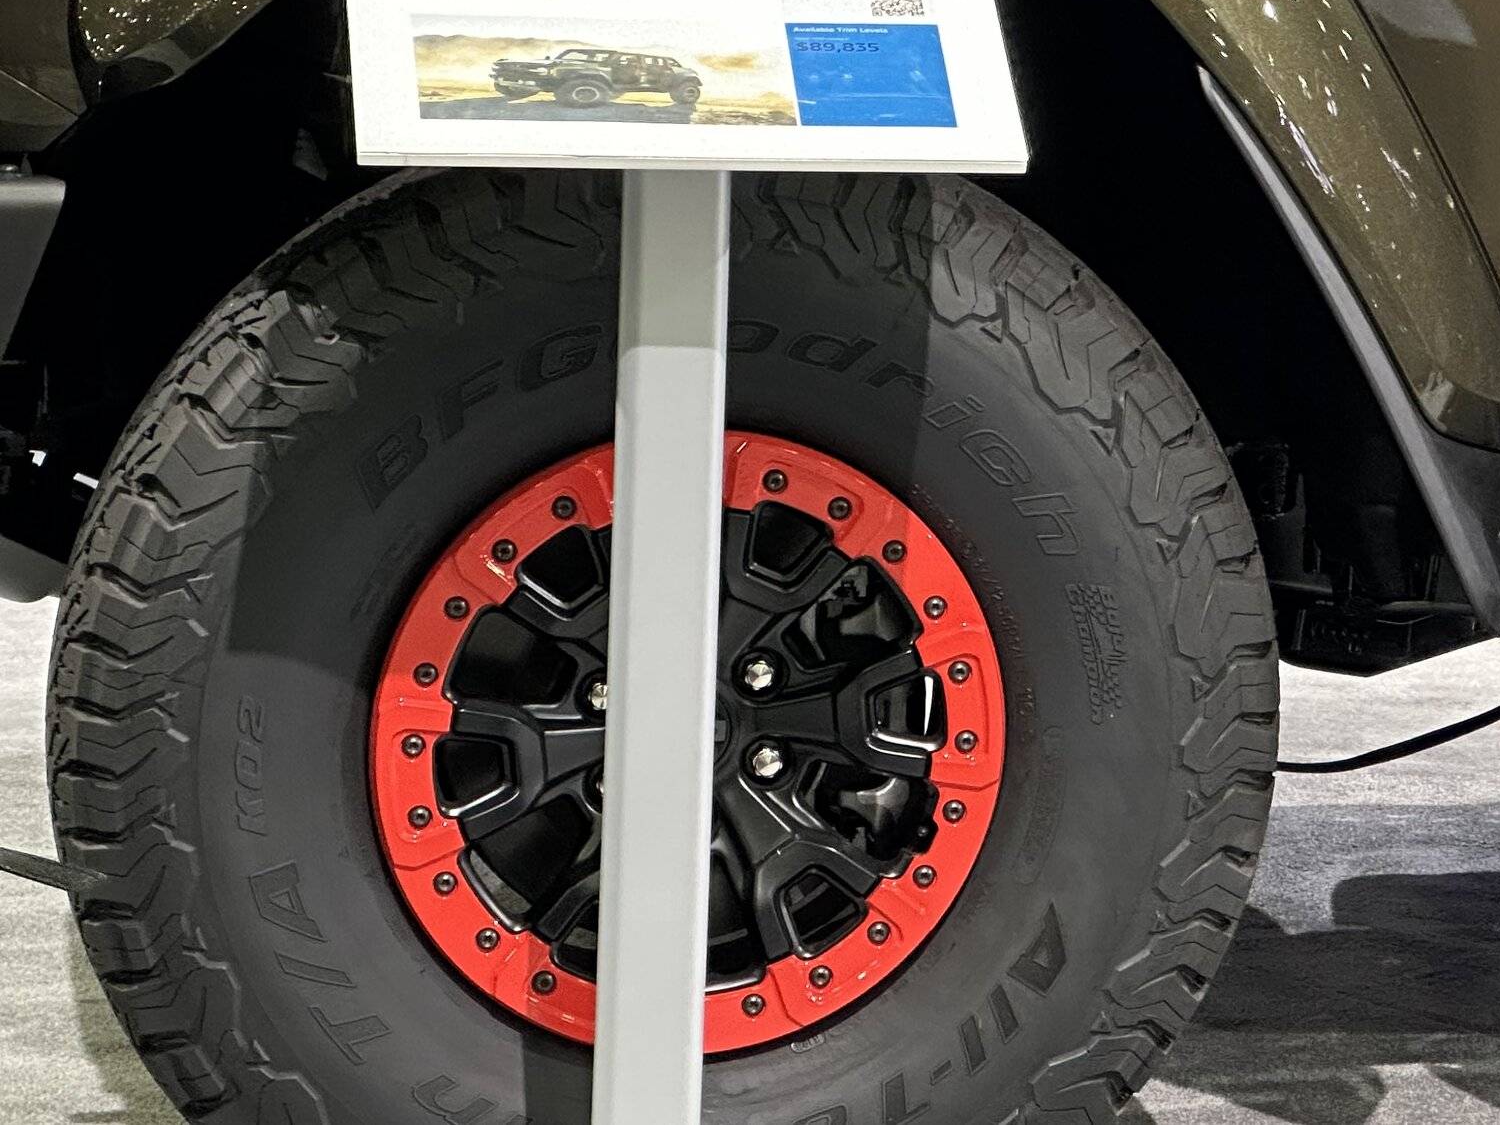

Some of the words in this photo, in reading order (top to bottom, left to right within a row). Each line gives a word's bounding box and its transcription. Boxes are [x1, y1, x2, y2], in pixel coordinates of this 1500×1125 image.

[796, 42, 880, 53] $89,835
[356, 315, 1082, 557] BFGodrich
[248, 860, 392, 1067] T/A
